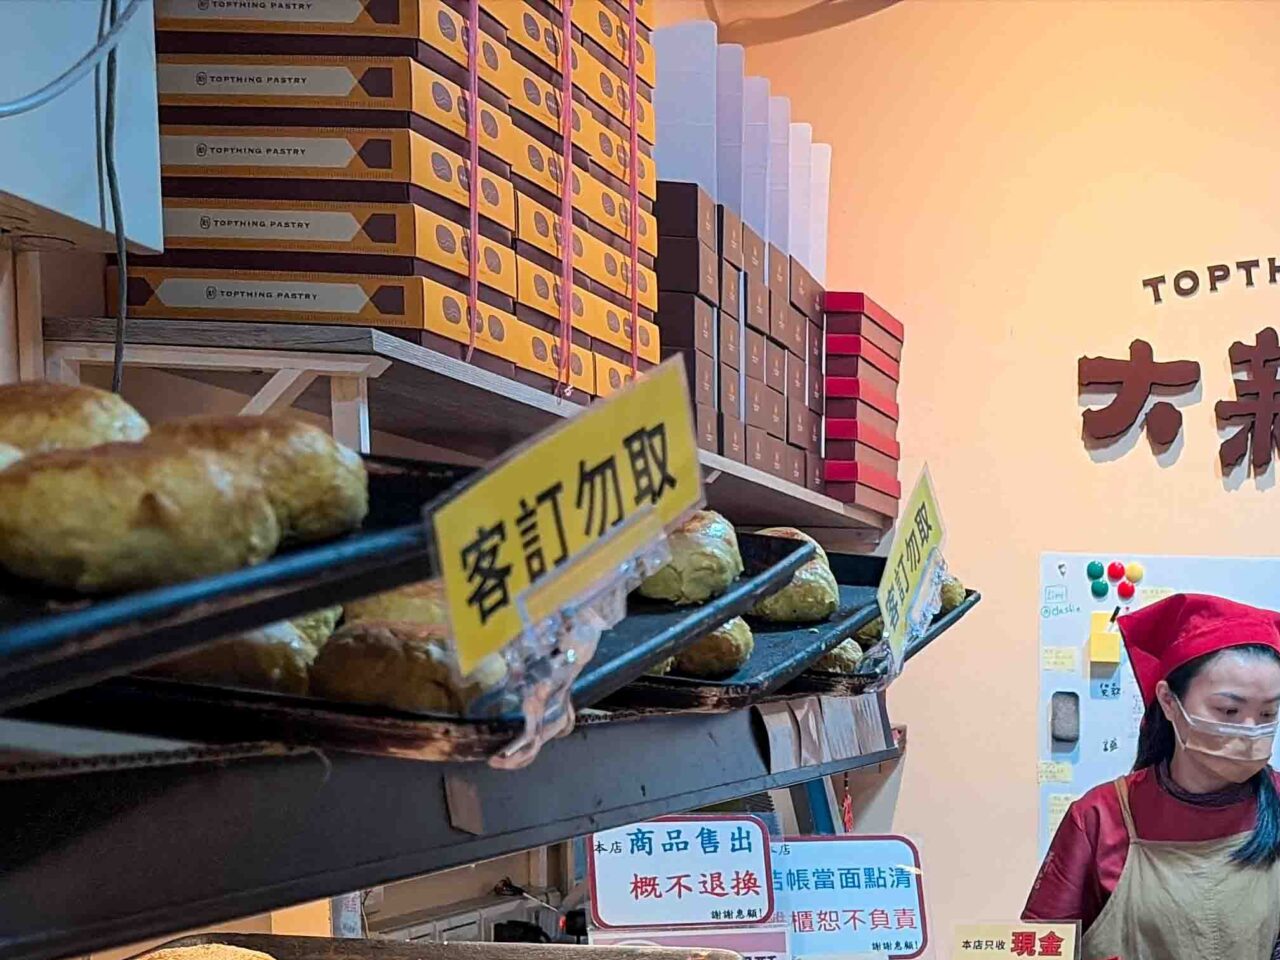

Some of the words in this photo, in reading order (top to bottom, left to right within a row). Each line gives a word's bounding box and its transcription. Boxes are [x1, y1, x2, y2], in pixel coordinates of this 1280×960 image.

[212, 1, 267, 9] TOPTHING
[270, 2, 313, 10] PASTRY
[209, 75, 262, 84] TOPTHING
[267, 76, 308, 84] PASTRY
[209, 147, 262, 155] TOPTHING
[213, 220, 267, 228] TOPTHING
[270, 221, 311, 229] PASTRY
[220, 290, 273, 299] TOPTHING
[277, 292, 318, 301] PASTRY
[460, 421, 679, 626] 客訂勿取
[885, 500, 933, 632] 客訂勿取
[594, 839, 623, 855] 本店
[626, 826, 753, 856] 商品售出
[629, 870, 763, 901] 概不退換
[961, 939, 1006, 951] 本店只收
[1010, 930, 1065, 957] 現金
